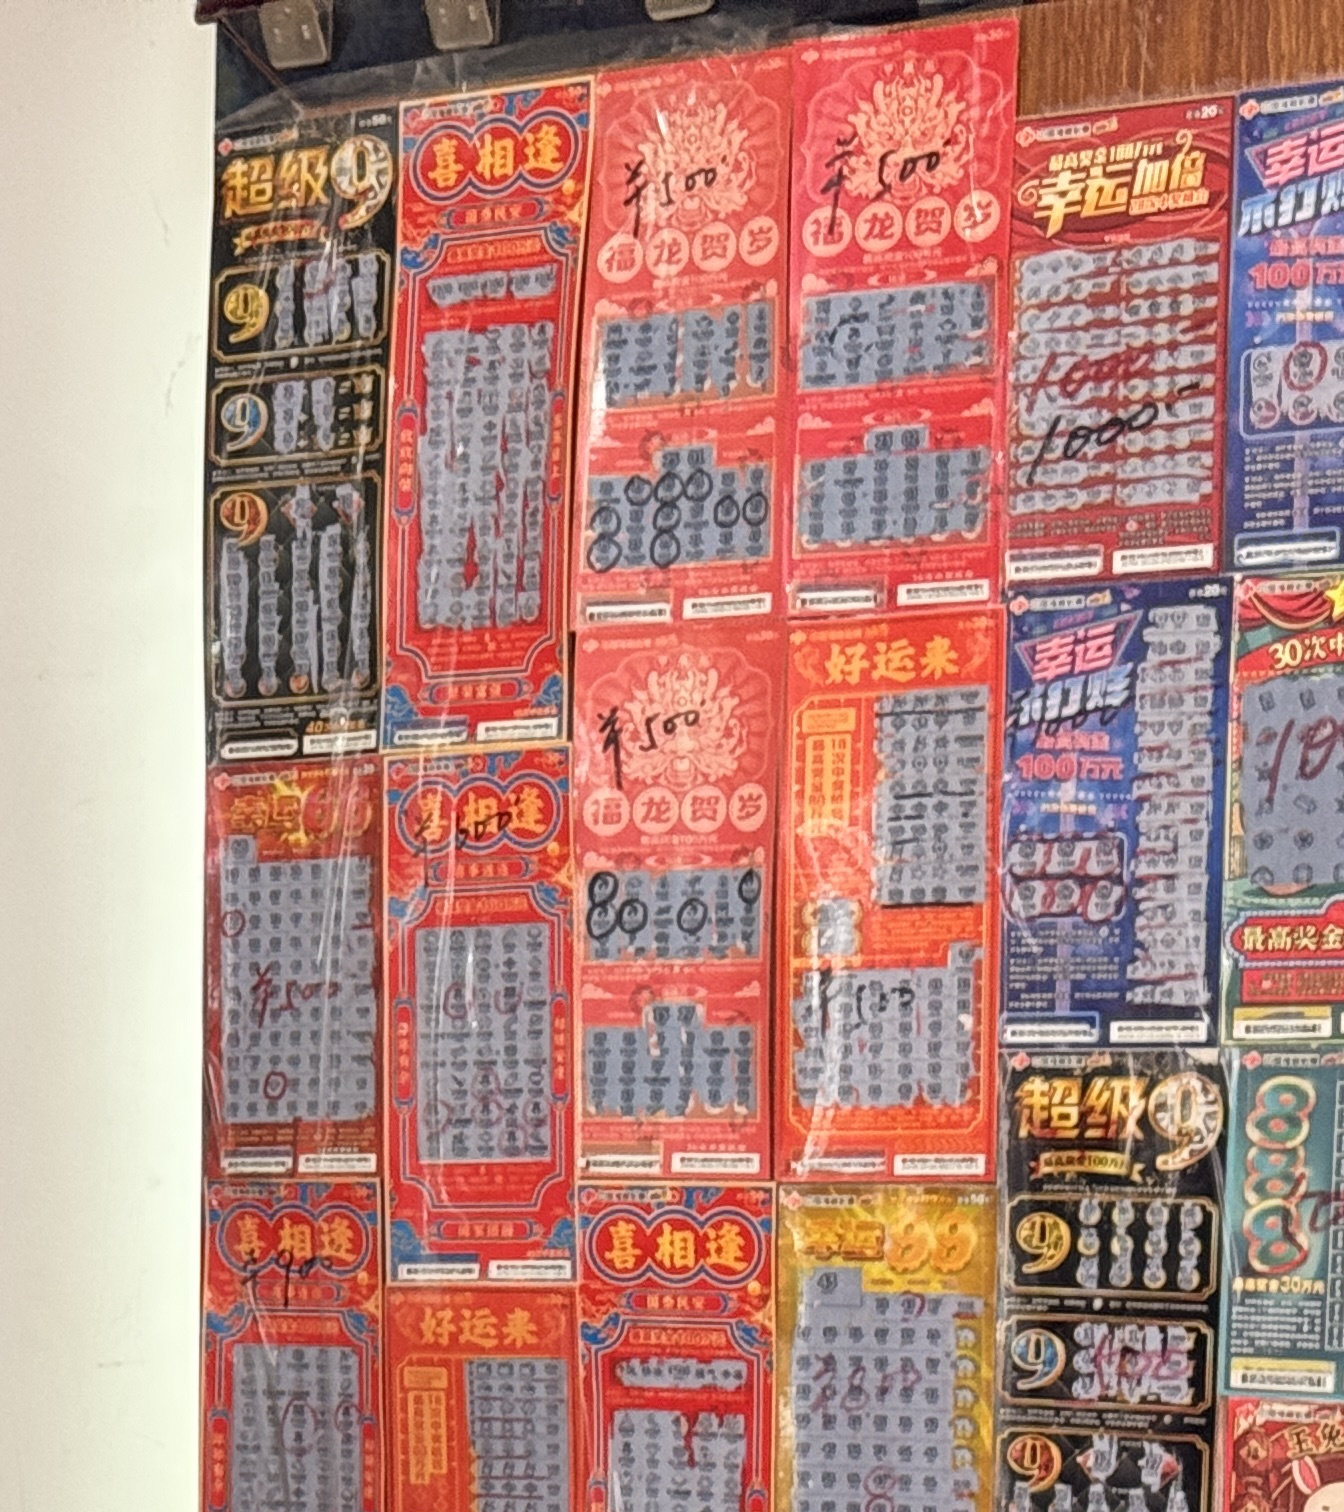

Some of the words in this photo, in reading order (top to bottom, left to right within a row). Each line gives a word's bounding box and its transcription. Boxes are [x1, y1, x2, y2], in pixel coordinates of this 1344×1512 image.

[425, 122, 569, 190] 喜相逢
[825, 638, 960, 686] 好运来
[1031, 621, 1118, 685] 幸运
[233, 1213, 358, 1264] 喜相逢
[603, 1219, 751, 1273] 喜相逢
[418, 1307, 540, 1348] 好运来
